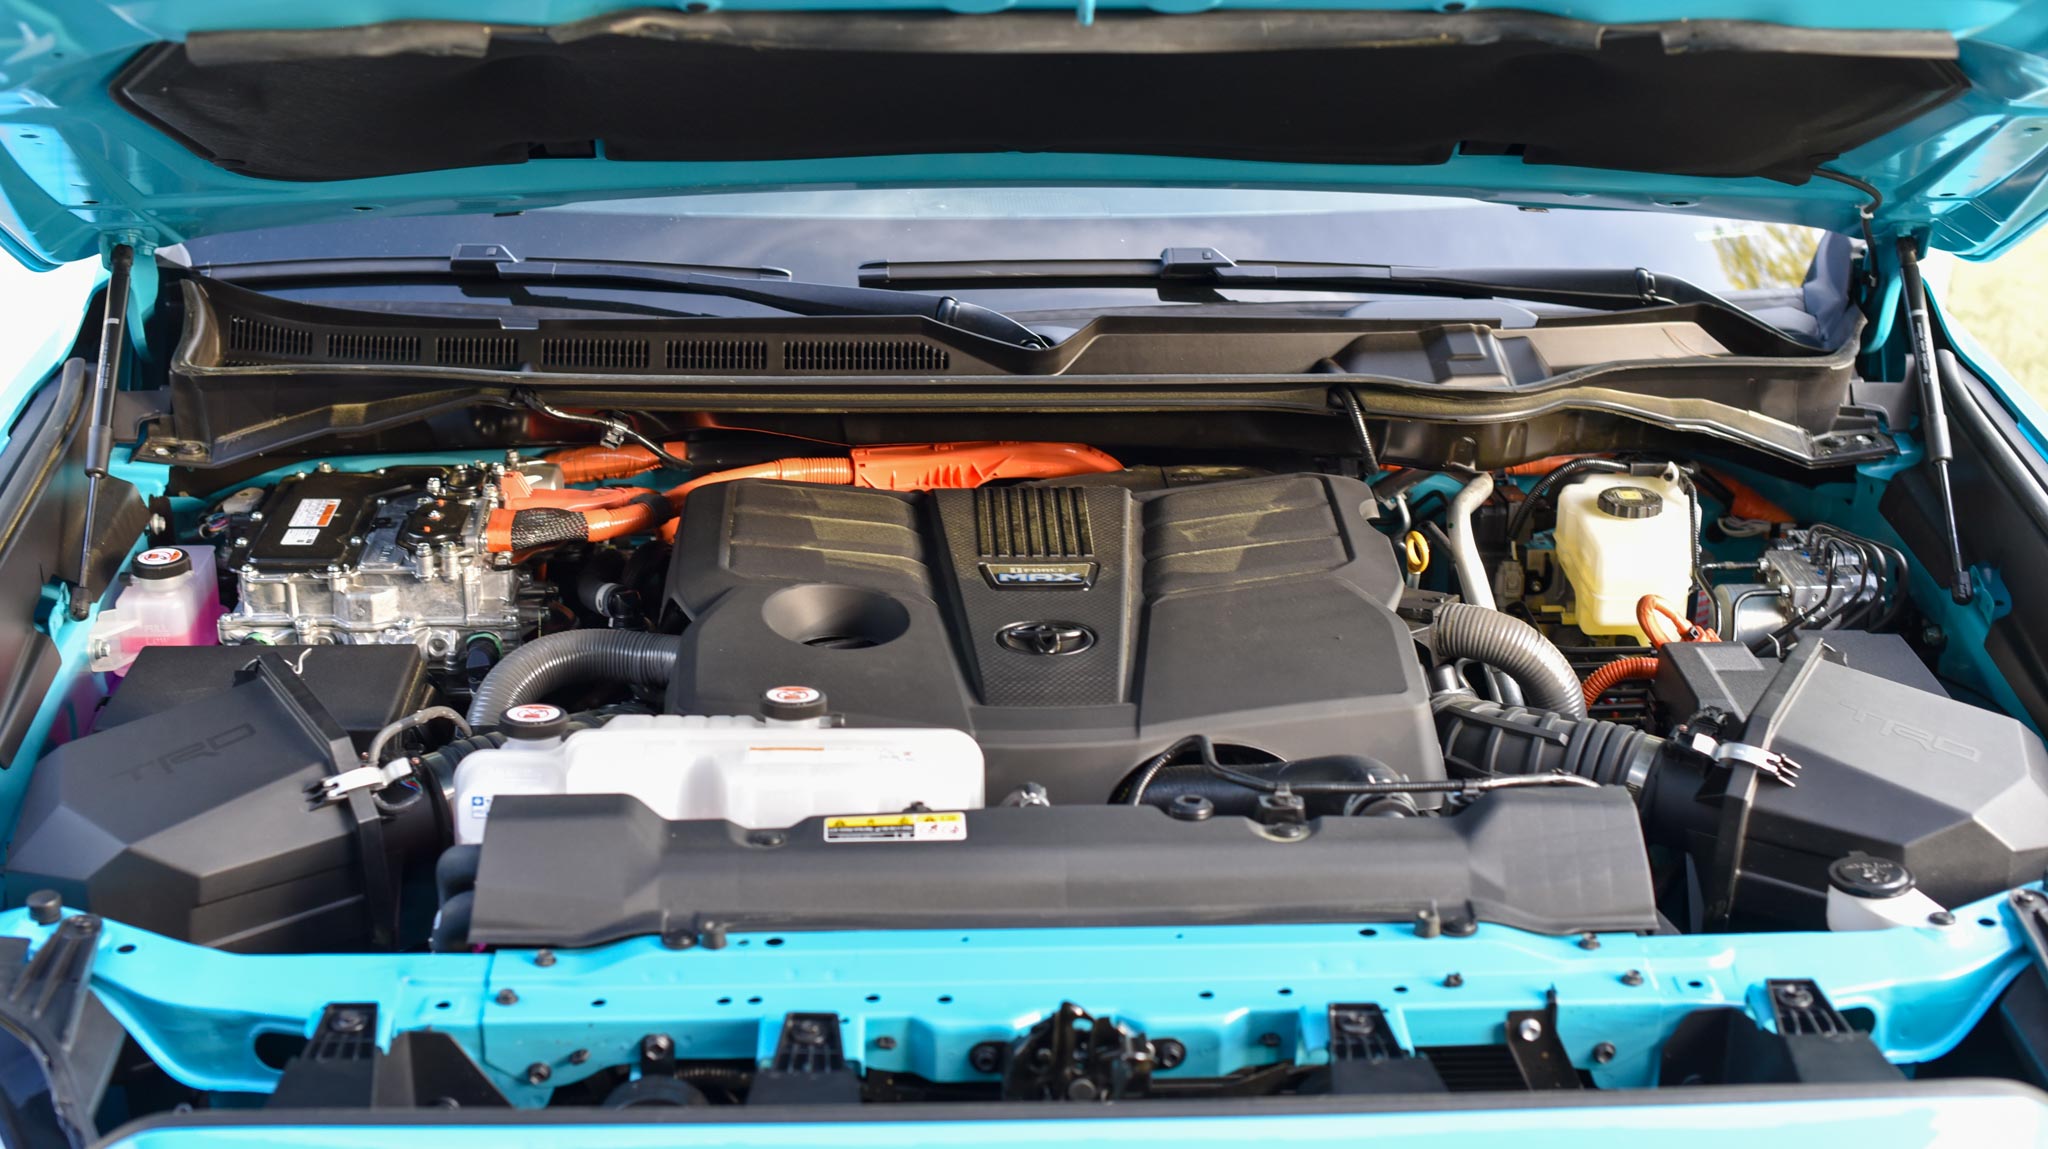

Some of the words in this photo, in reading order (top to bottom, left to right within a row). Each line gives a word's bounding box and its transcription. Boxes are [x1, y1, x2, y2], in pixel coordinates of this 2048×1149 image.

[998, 573, 1082, 582] MAX
[110, 722, 256, 781] TRD
[1839, 700, 1982, 763] TRD
